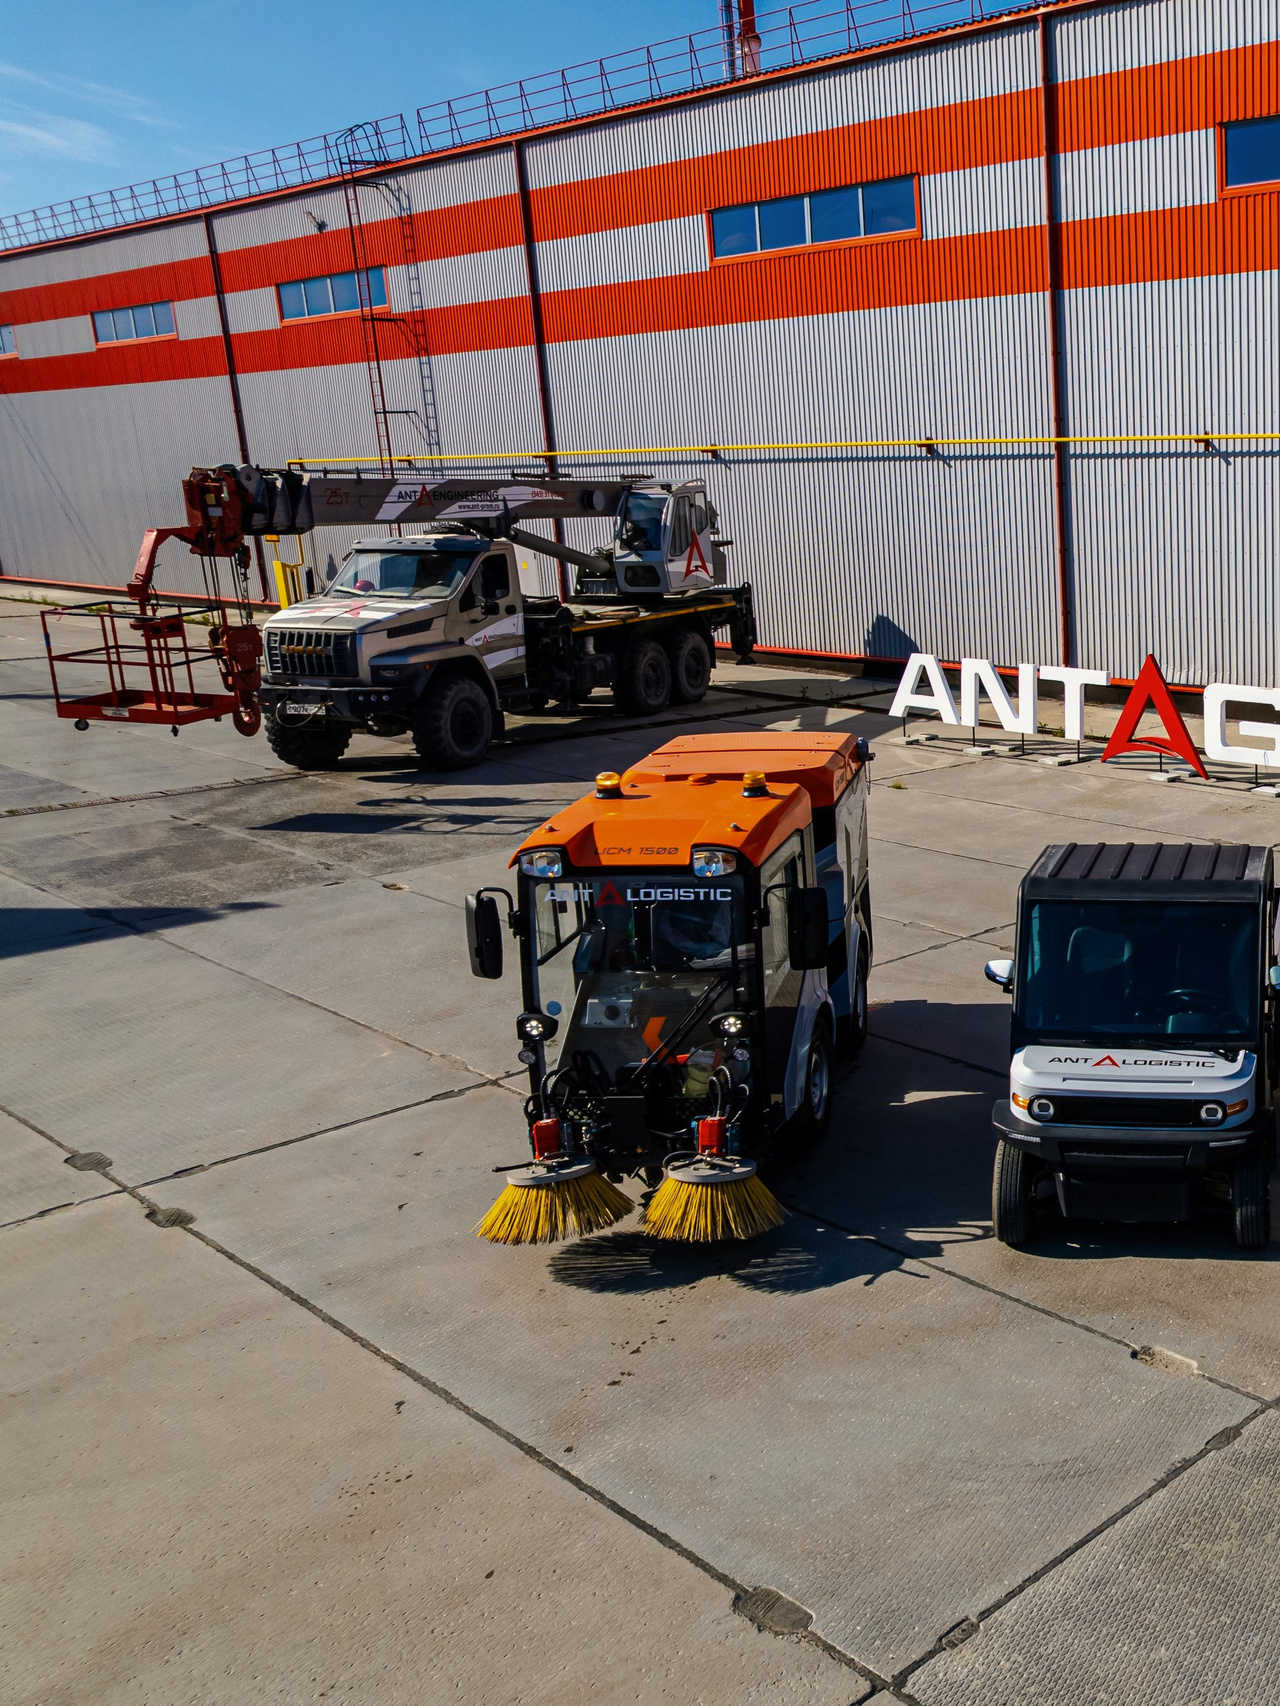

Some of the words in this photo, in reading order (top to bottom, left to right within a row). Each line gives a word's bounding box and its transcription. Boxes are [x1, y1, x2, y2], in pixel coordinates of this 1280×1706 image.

[397, 490, 418, 501] ANT
[433, 490, 499, 501] ENGINEERING
[458, 503, 500, 511] www.ant-prom.ru
[889, 653, 1111, 741] ANT
[595, 847, 631, 855] UCM
[639, 847, 679, 855] 1500
[543, 889, 593, 901] ANT
[627, 888, 732, 901] LOGISTIC
[1122, 1059, 1216, 1068] LOGISTIC
